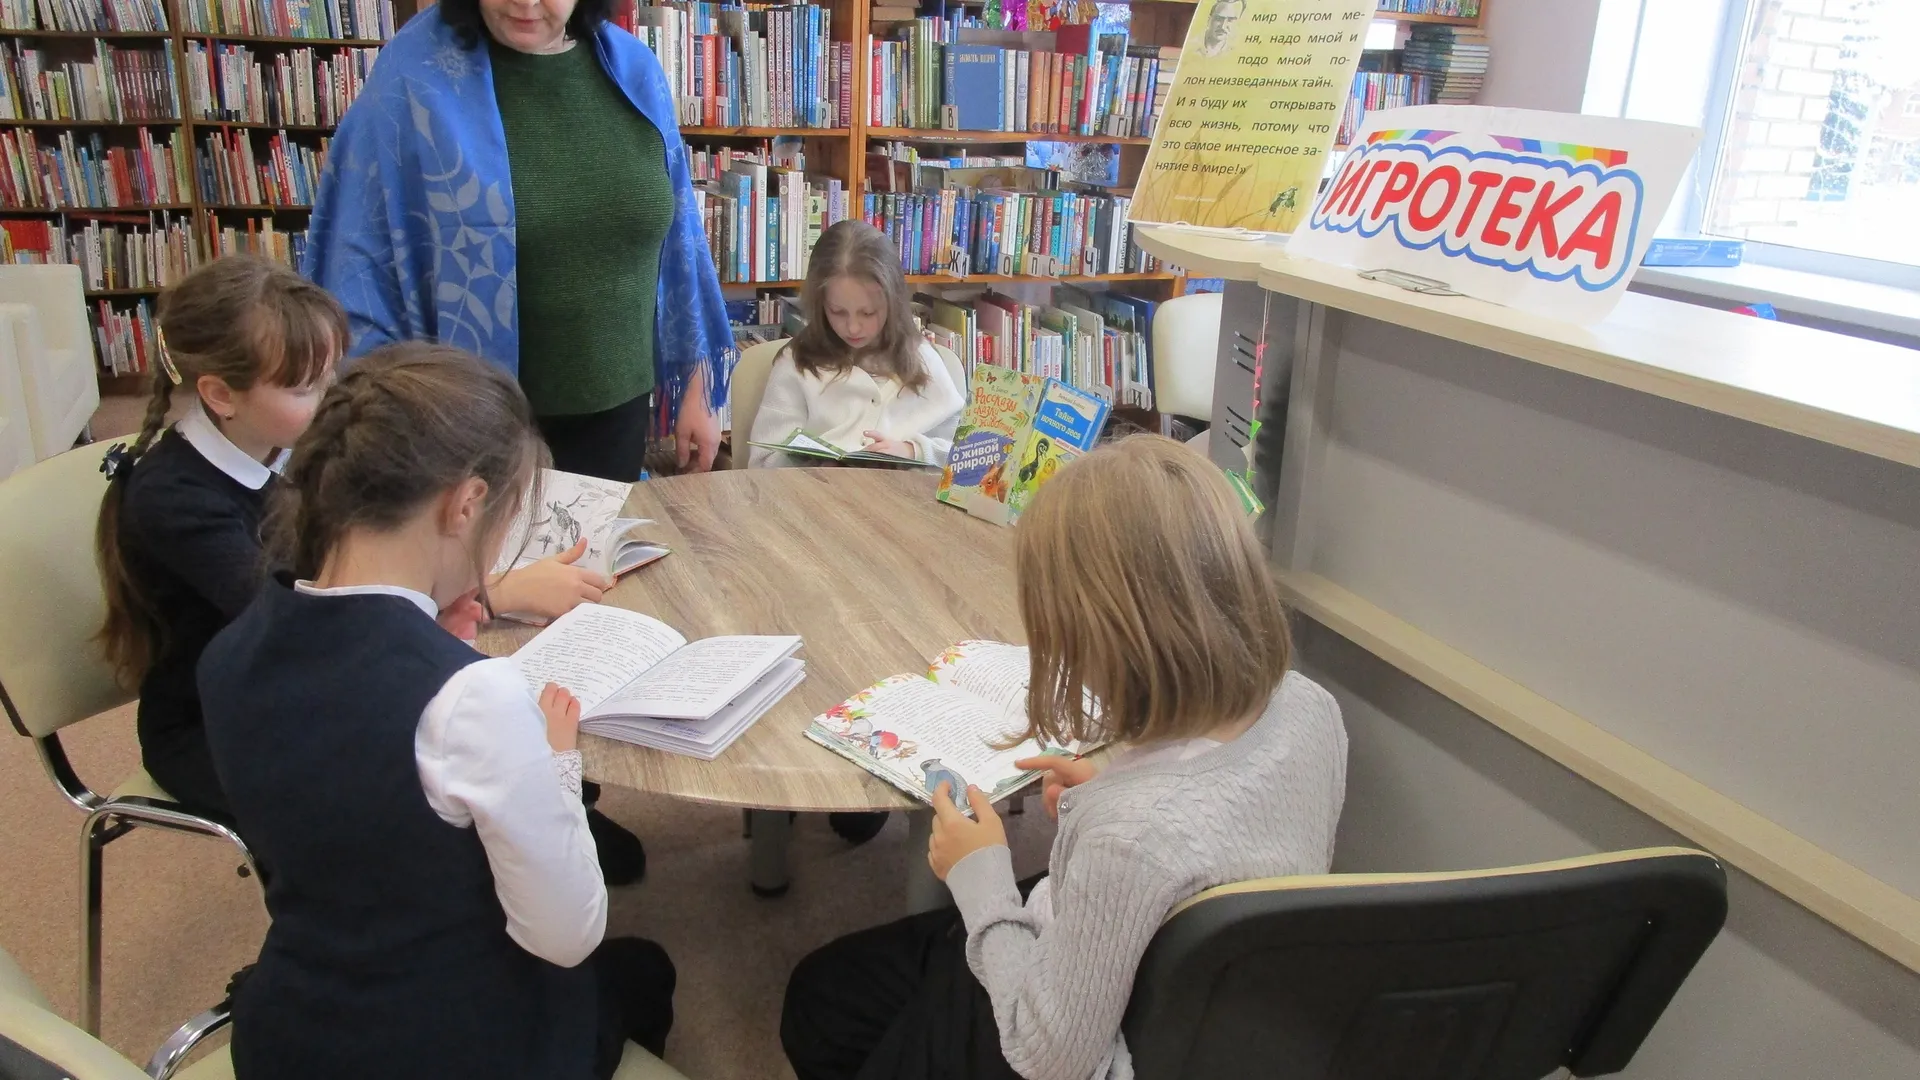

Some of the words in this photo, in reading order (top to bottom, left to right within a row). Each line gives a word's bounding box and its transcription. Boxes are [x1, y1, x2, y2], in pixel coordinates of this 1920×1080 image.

[1251, 13, 1278, 24] мир
[1286, 12, 1332, 24] кругом
[1342, 11, 1366, 20] ме-
[1244, 34, 1262, 44] ня,
[1270, 34, 1301, 45] надо
[1307, 31, 1343, 43] мной
[1349, 33, 1358, 42] и
[1237, 56, 1268, 66] подо
[1276, 54, 1312, 65] мной
[1330, 56, 1350, 65] по-
[1183, 76, 1206, 85] лон
[1208, 77, 1298, 88] неизведанных
[1302, 77, 1334, 88] тайн.
[1176, 96, 1186, 106] И
[1200, 97, 1228, 108] буду
[1232, 100, 1248, 108] их
[1269, 100, 1336, 111] открывать
[948, 108, 954, 128] В
[1169, 120, 1192, 128] всю
[1200, 120, 1242, 132] жизнь,
[1251, 121, 1299, 134] потому
[1308, 124, 1330, 133] что
[1162, 141, 1180, 150] это
[1184, 142, 1221, 151] самое
[1224, 144, 1299, 156] интересное
[1303, 146, 1323, 156] за-
[1155, 161, 1189, 172] нятие
[1201, 164, 1247, 176] мире!»
[1321, 160, 1622, 270] ИГРОТЕКА
[948, 250, 960, 272] Ж
[1003, 256, 1010, 275] О
[1031, 257, 1038, 275] П
[1048, 258, 1055, 276] С
[1085, 250, 1093, 272] Ч
[975, 387, 1017, 412] Рассказы
[952, 453, 959, 462] о
[962, 442, 999, 460] живой
[950, 452, 1000, 473] природе
